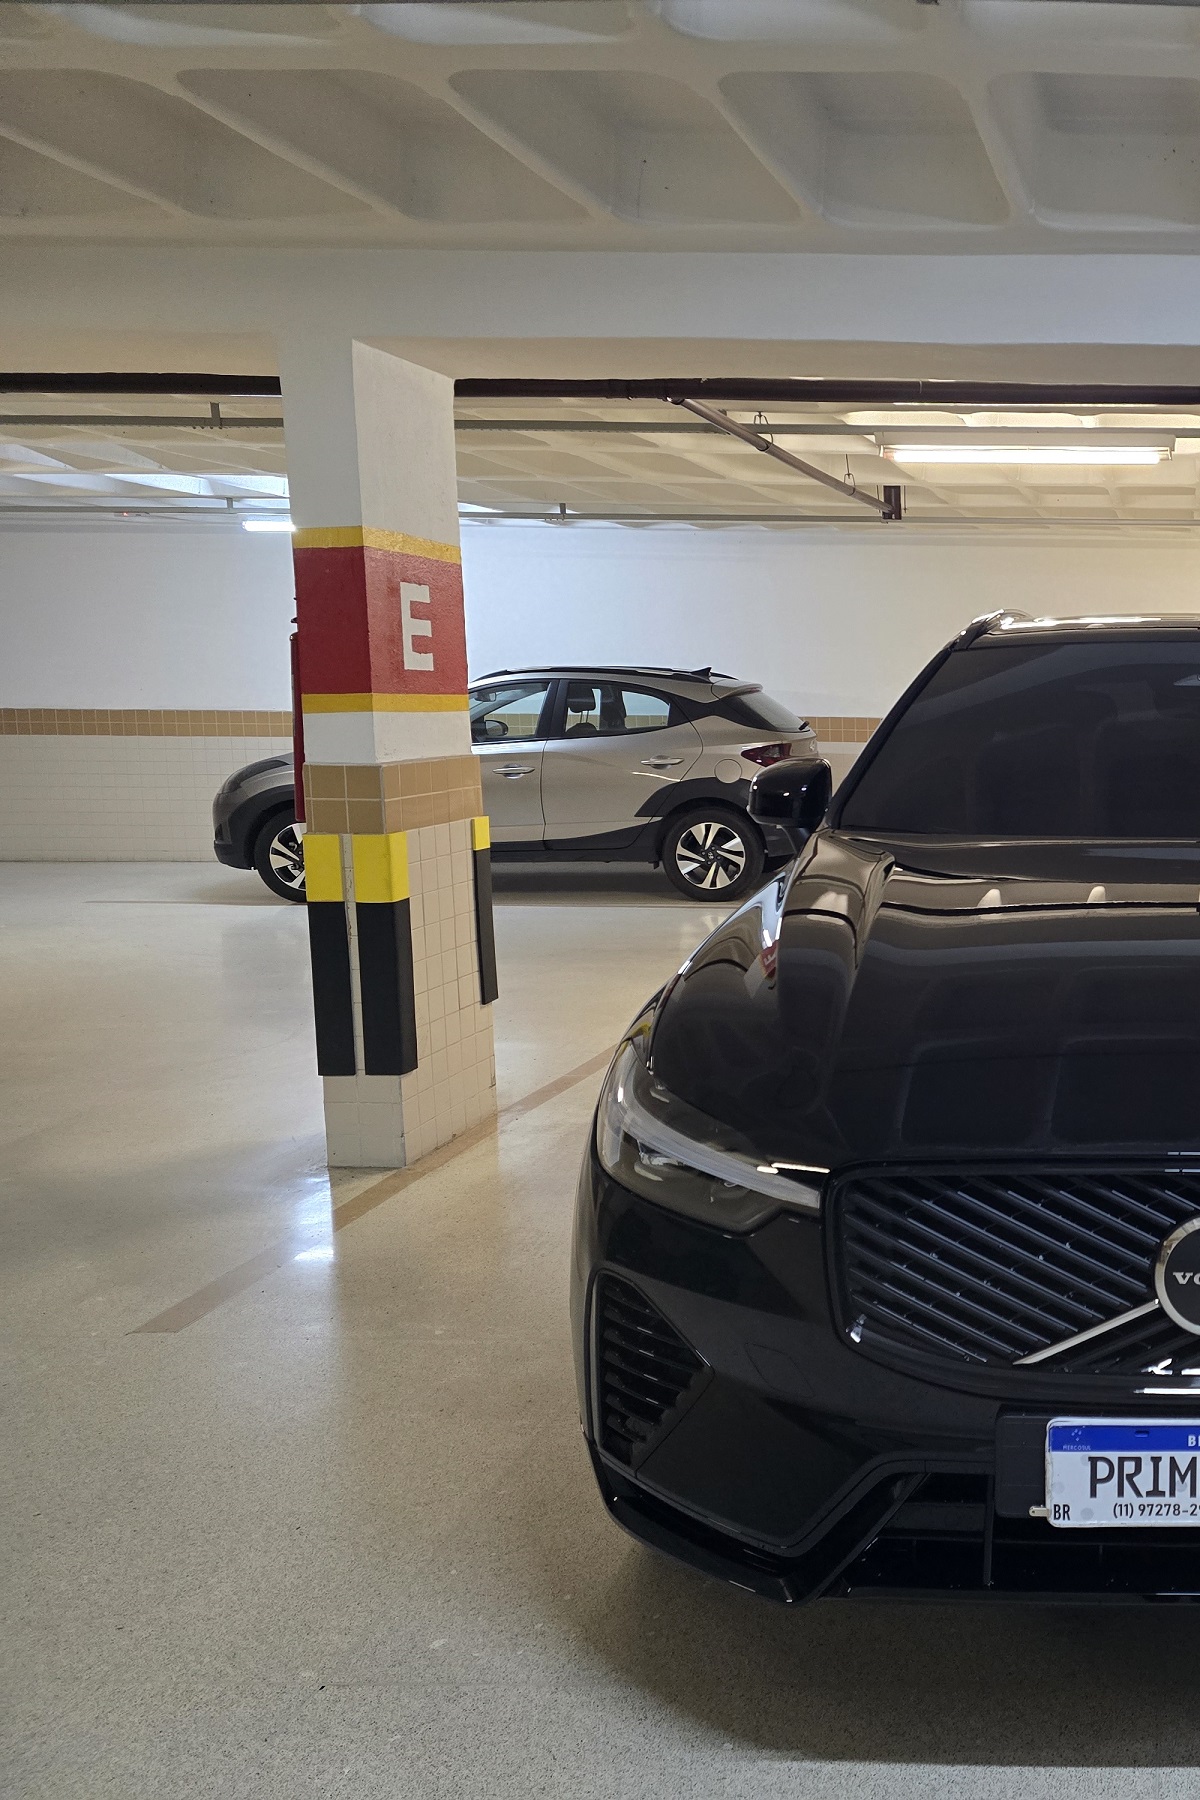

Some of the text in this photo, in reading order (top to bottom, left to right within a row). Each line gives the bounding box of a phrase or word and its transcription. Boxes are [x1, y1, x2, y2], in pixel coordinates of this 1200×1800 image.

[400, 581, 434, 671] E
[1053, 1503, 1071, 1521] BR
[1113, 1502, 1134, 1519] (11)
